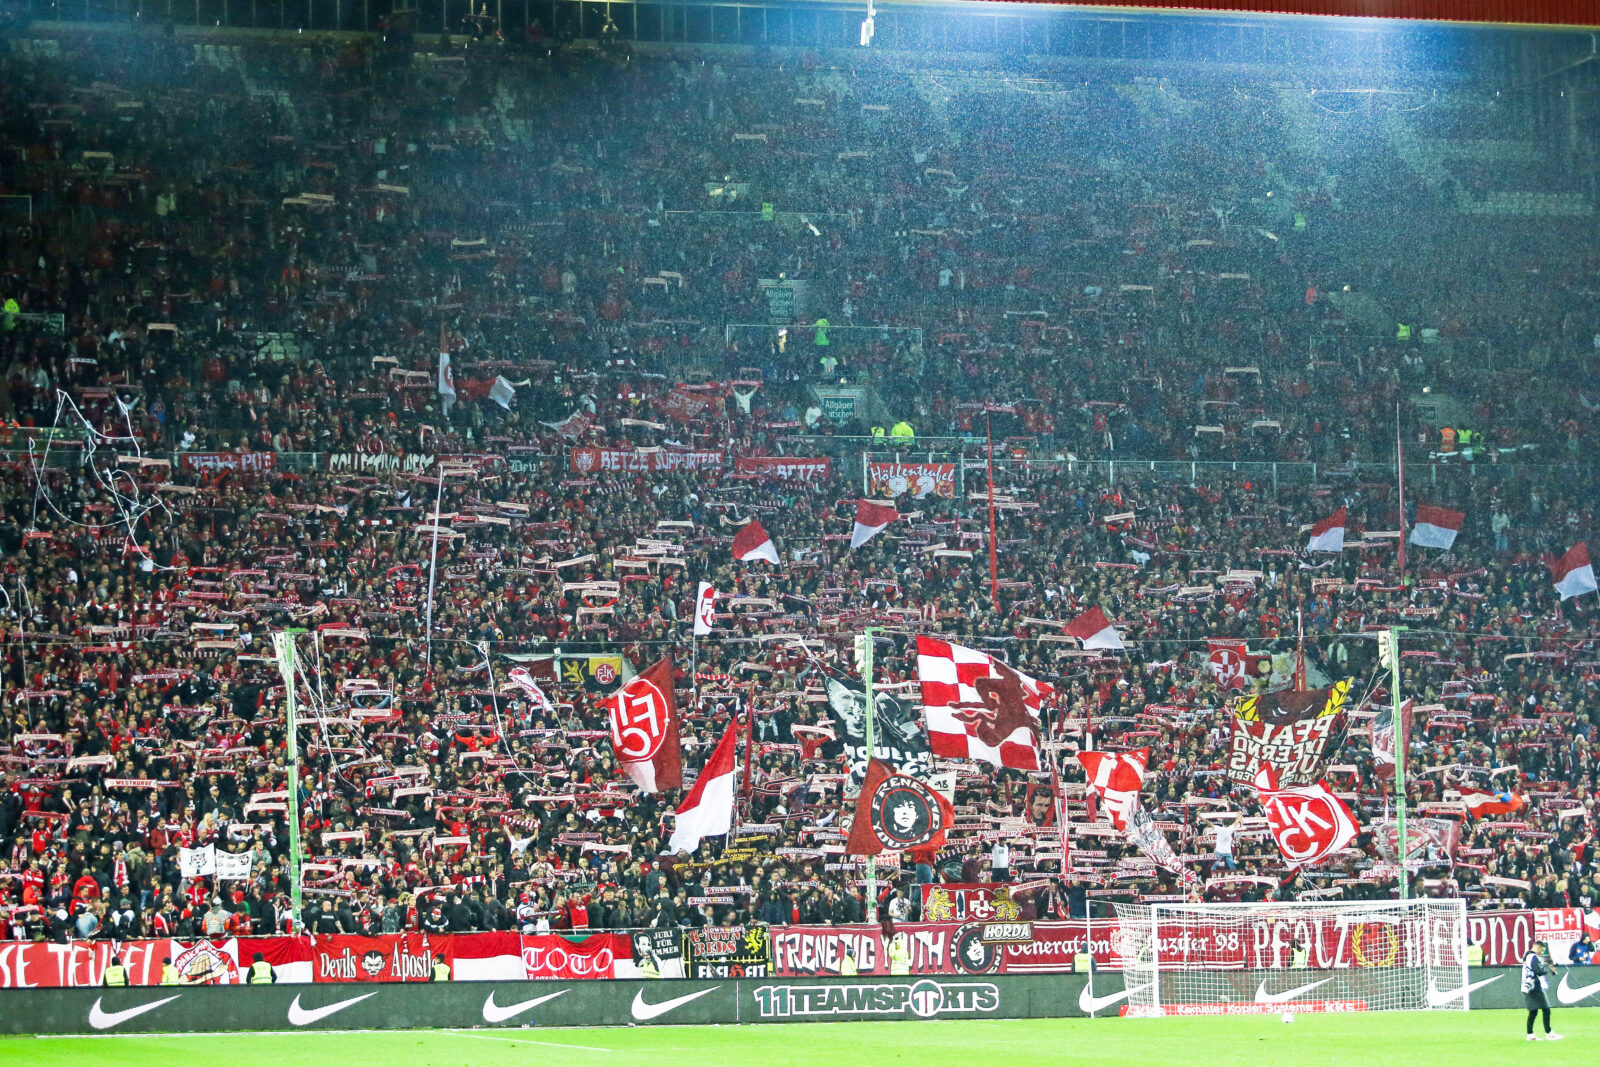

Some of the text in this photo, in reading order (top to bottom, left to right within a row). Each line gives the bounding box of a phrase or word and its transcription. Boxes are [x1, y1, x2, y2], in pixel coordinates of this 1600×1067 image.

[825, 400, 854, 411] Allgäuer
[827, 409, 854, 418] atschen
[601, 451, 649, 470] BETZE
[870, 464, 955, 484] Höllenteufel
[115, 779, 152, 787] WESTKURVE
[1534, 908, 1582, 930] 50+1
[653, 930, 674, 940] JURI
[983, 924, 1032, 940] HORDA
[656, 938, 673, 948] FÜR
[694, 941, 737, 956] REDS
[775, 930, 946, 975] FRENETIC YUTH
[320, 947, 357, 978] Devils
[522, 947, 613, 975] TOTO
